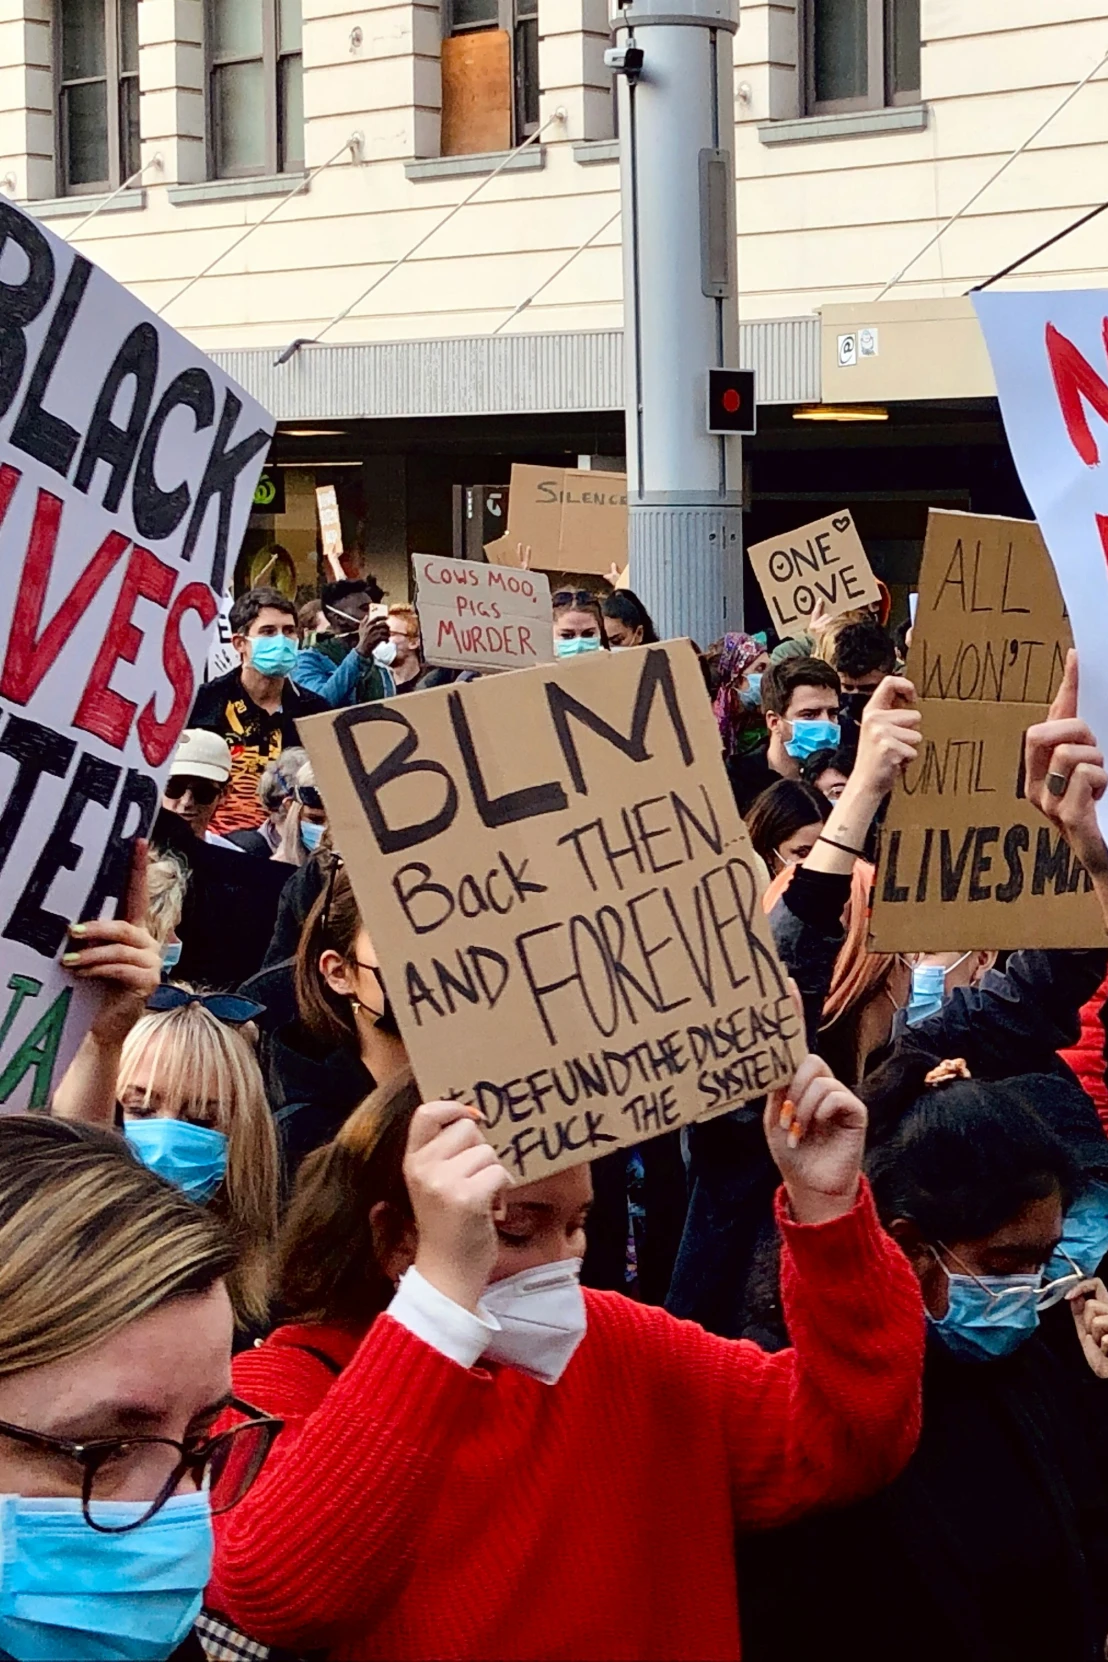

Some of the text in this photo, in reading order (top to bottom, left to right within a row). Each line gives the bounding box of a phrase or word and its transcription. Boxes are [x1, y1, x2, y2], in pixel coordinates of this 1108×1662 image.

[424, 562, 480, 587] COWS
[769, 532, 841, 584] ONE
[932, 538, 1031, 614] ALL
[0, 463, 219, 768] VES
[456, 596, 502, 619] PIGS
[771, 565, 866, 626] LOVE
[437, 619, 538, 656] MURDER
[921, 638, 1045, 703] WON'T
[332, 648, 696, 855] BLM
[901, 738, 996, 797] UNTIL
[392, 850, 548, 935] Back
[882, 823, 1030, 904] LIVES
[405, 857, 789, 1047] AND FOREVER
[621, 1085, 682, 1133] THE
[698, 1040, 799, 1108] SYSTEM
